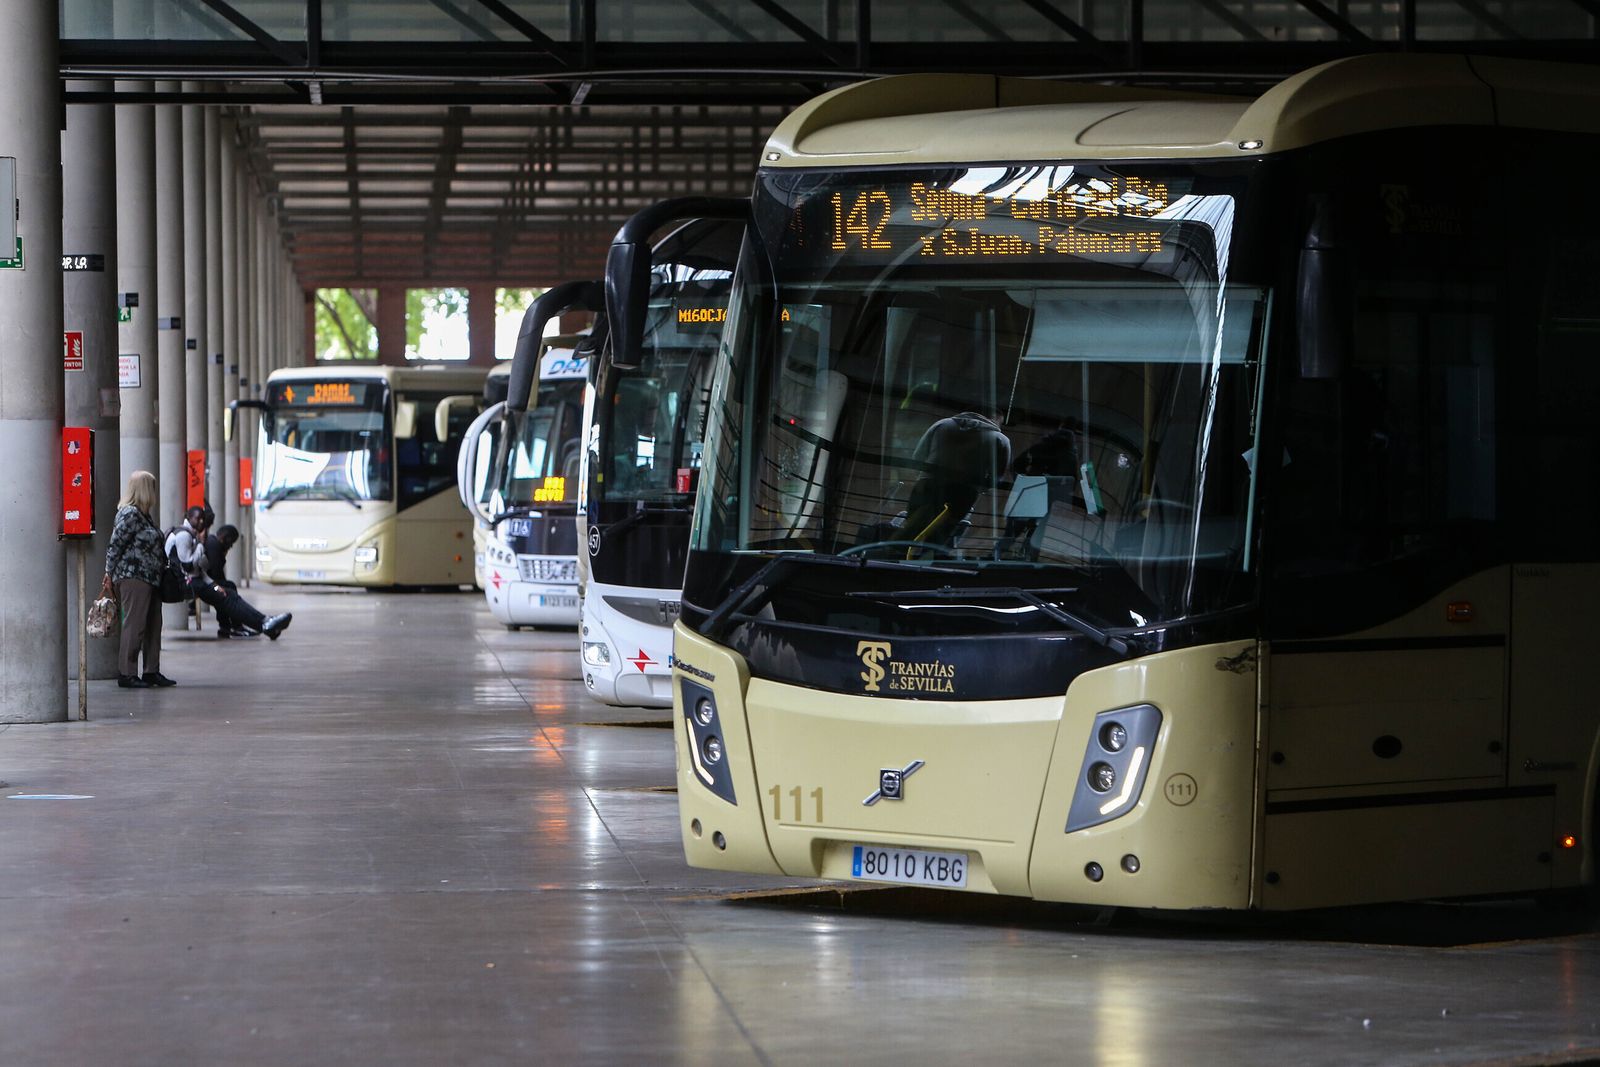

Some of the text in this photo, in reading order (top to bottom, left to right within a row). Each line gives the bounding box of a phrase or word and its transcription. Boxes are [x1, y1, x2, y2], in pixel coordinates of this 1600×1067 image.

[831, 192, 892, 249] 142
[1039, 226, 1162, 254] Palomares
[889, 659, 955, 678] TRANVÍAS
[889, 676, 955, 693] de SEVILLA
[768, 784, 824, 823] 111
[1168, 783, 1192, 796] 111
[864, 851, 916, 879] 8010
[923, 855, 963, 883] KBG
